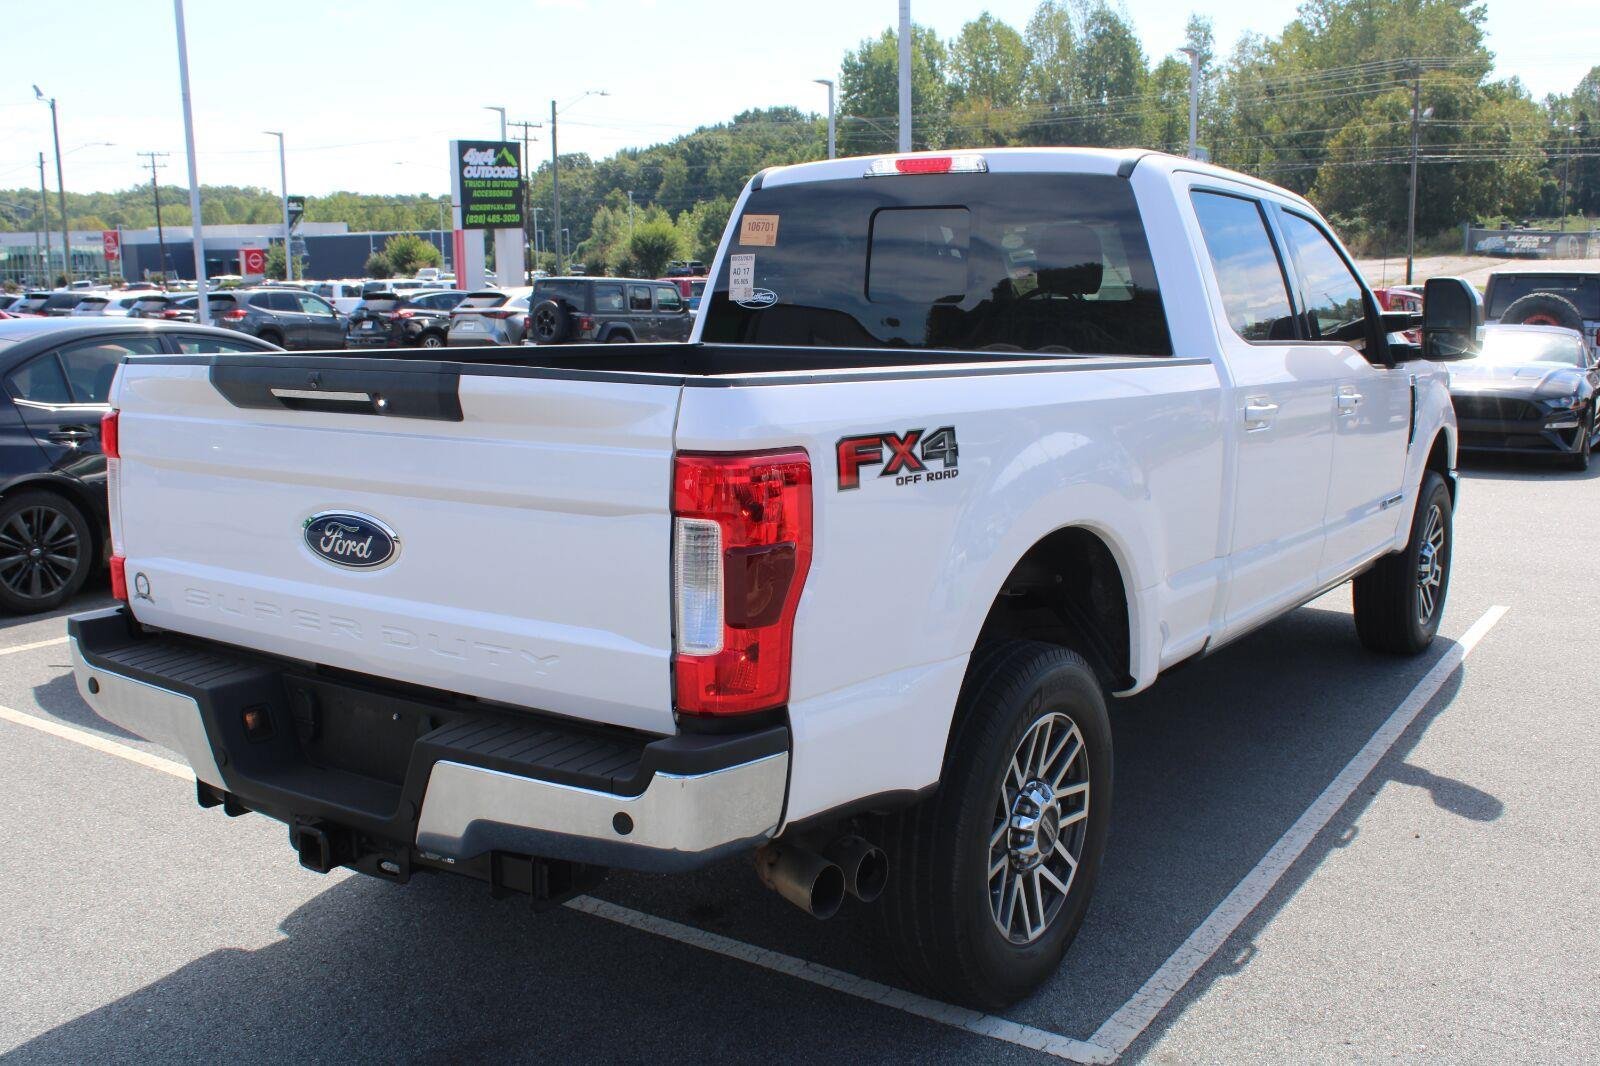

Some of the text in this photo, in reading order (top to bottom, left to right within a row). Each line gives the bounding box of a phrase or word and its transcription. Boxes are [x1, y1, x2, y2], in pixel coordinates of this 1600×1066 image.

[463, 166, 518, 178] OUTDOORS
[464, 180, 486, 188] TRUCK
[491, 180, 519, 188] OUTDOOR
[472, 189, 513, 198] ACCESSORIES
[747, 221, 775, 232] 106701
[743, 267, 750, 276] 17
[836, 425, 959, 492] FX4
[896, 468, 959, 487] OFF ROAD
[320, 521, 374, 559] Ford
[184, 588, 560, 676] SUPER DUTY
